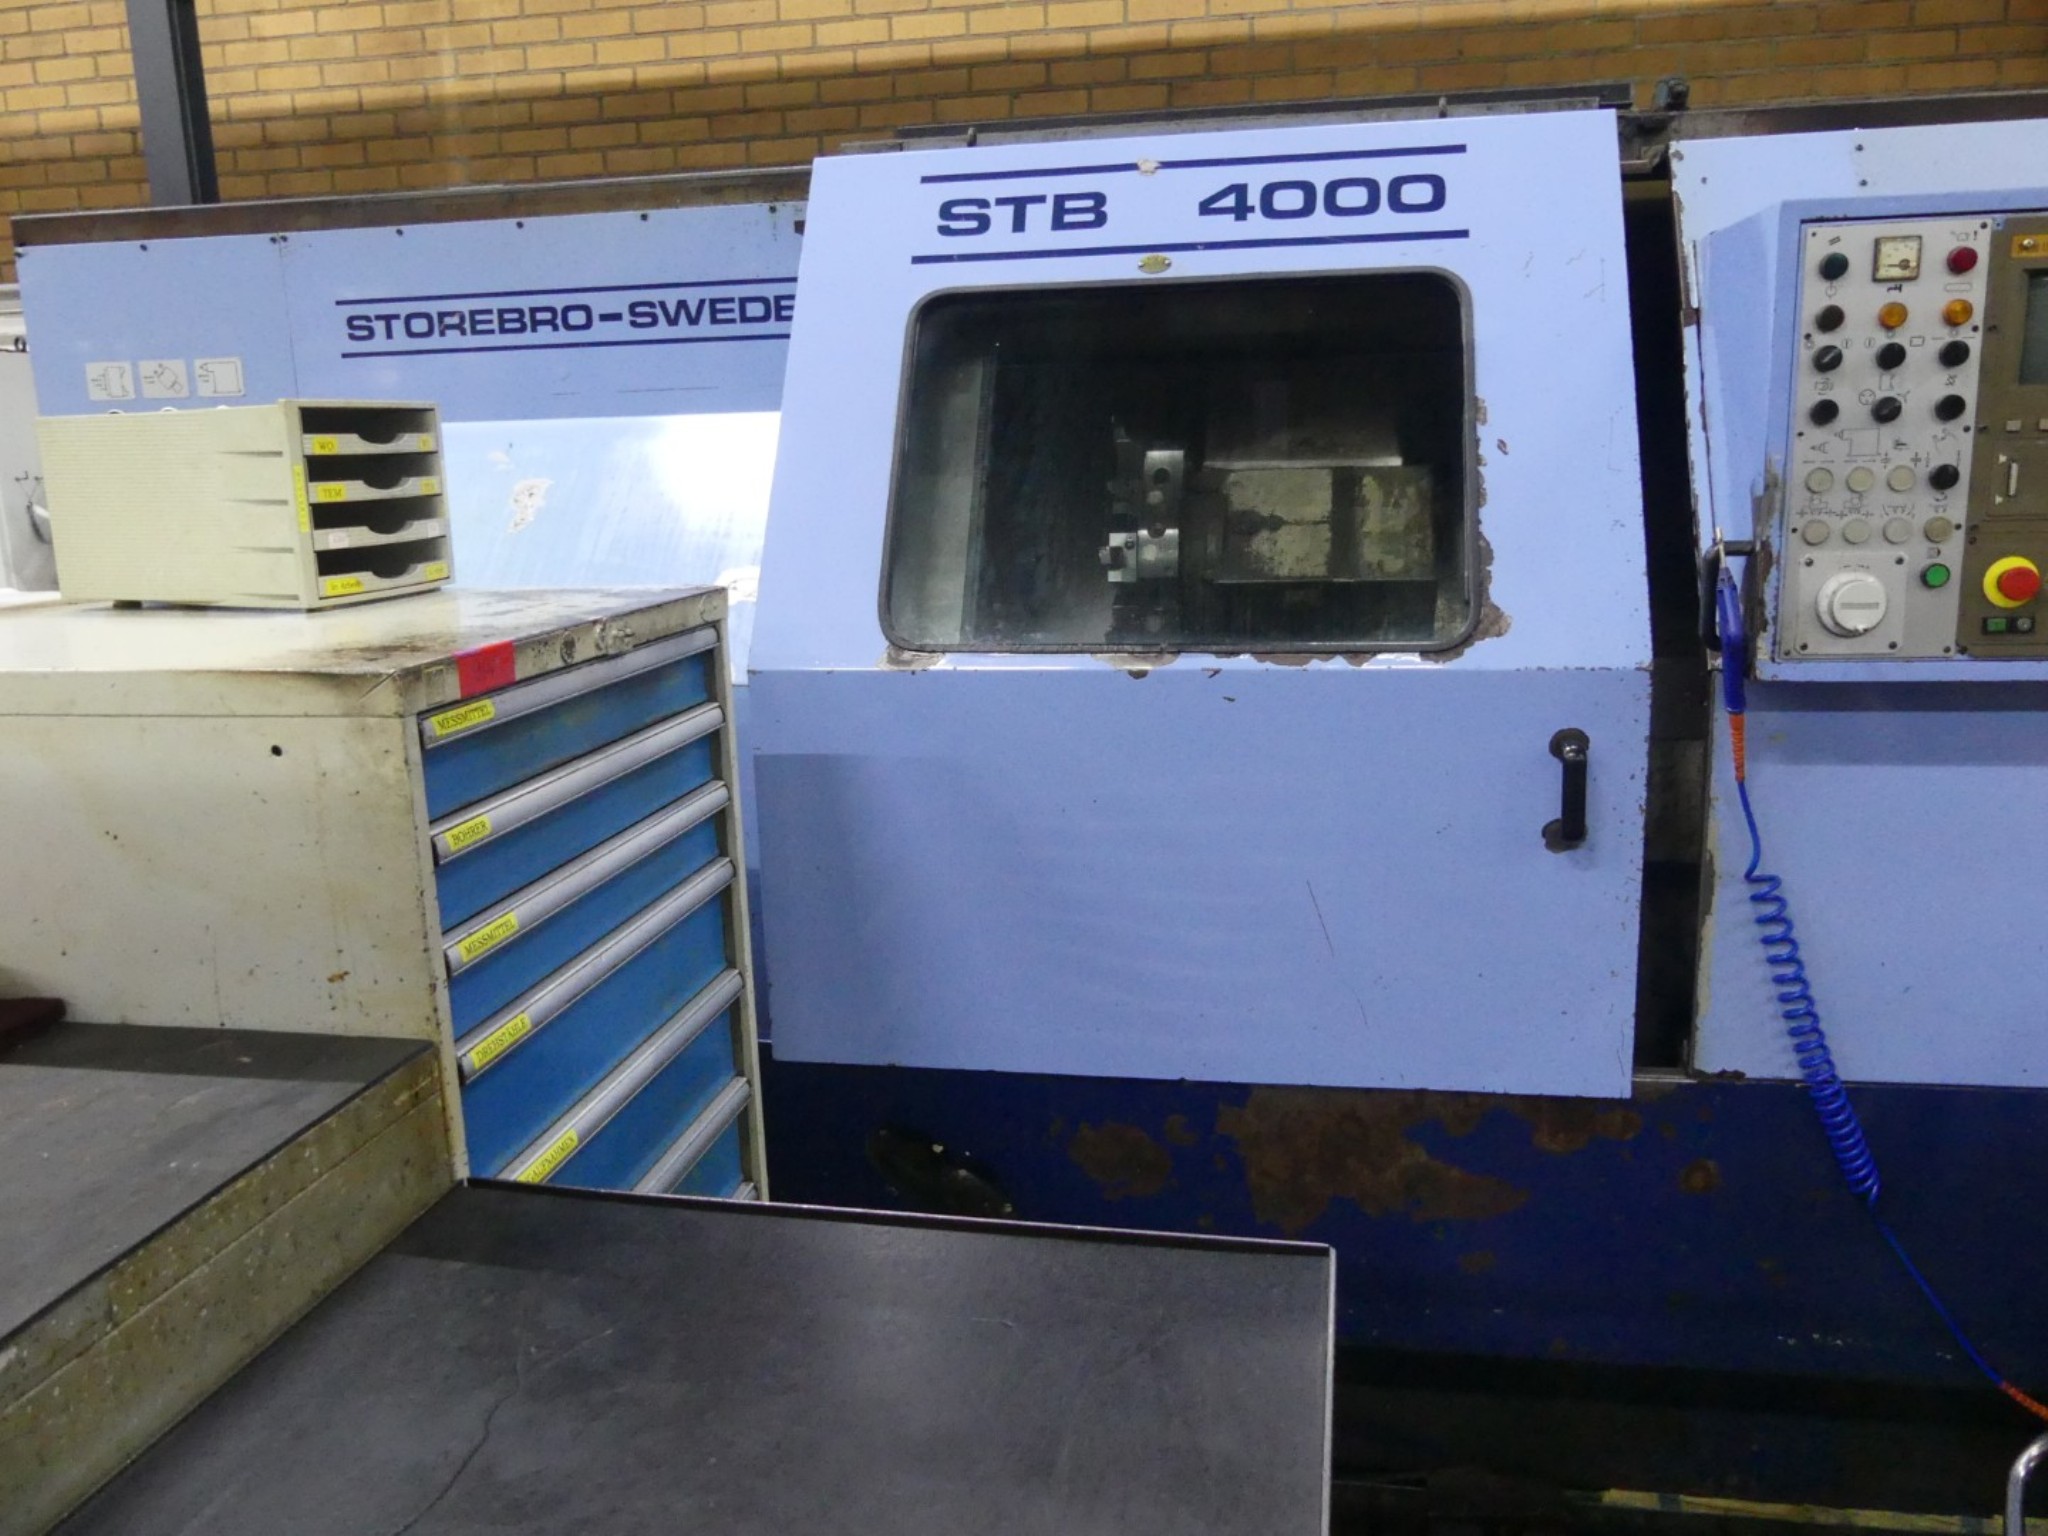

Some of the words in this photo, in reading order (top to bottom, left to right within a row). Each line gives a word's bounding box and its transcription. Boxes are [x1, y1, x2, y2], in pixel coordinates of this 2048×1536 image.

[937, 190, 1108, 237] STB
[1197, 173, 1447, 222] 4000
[436, 704, 493, 732] MESSMITTEL
[450, 819, 490, 848] BOHRER
[463, 917, 516, 956] MESSMITTEL
